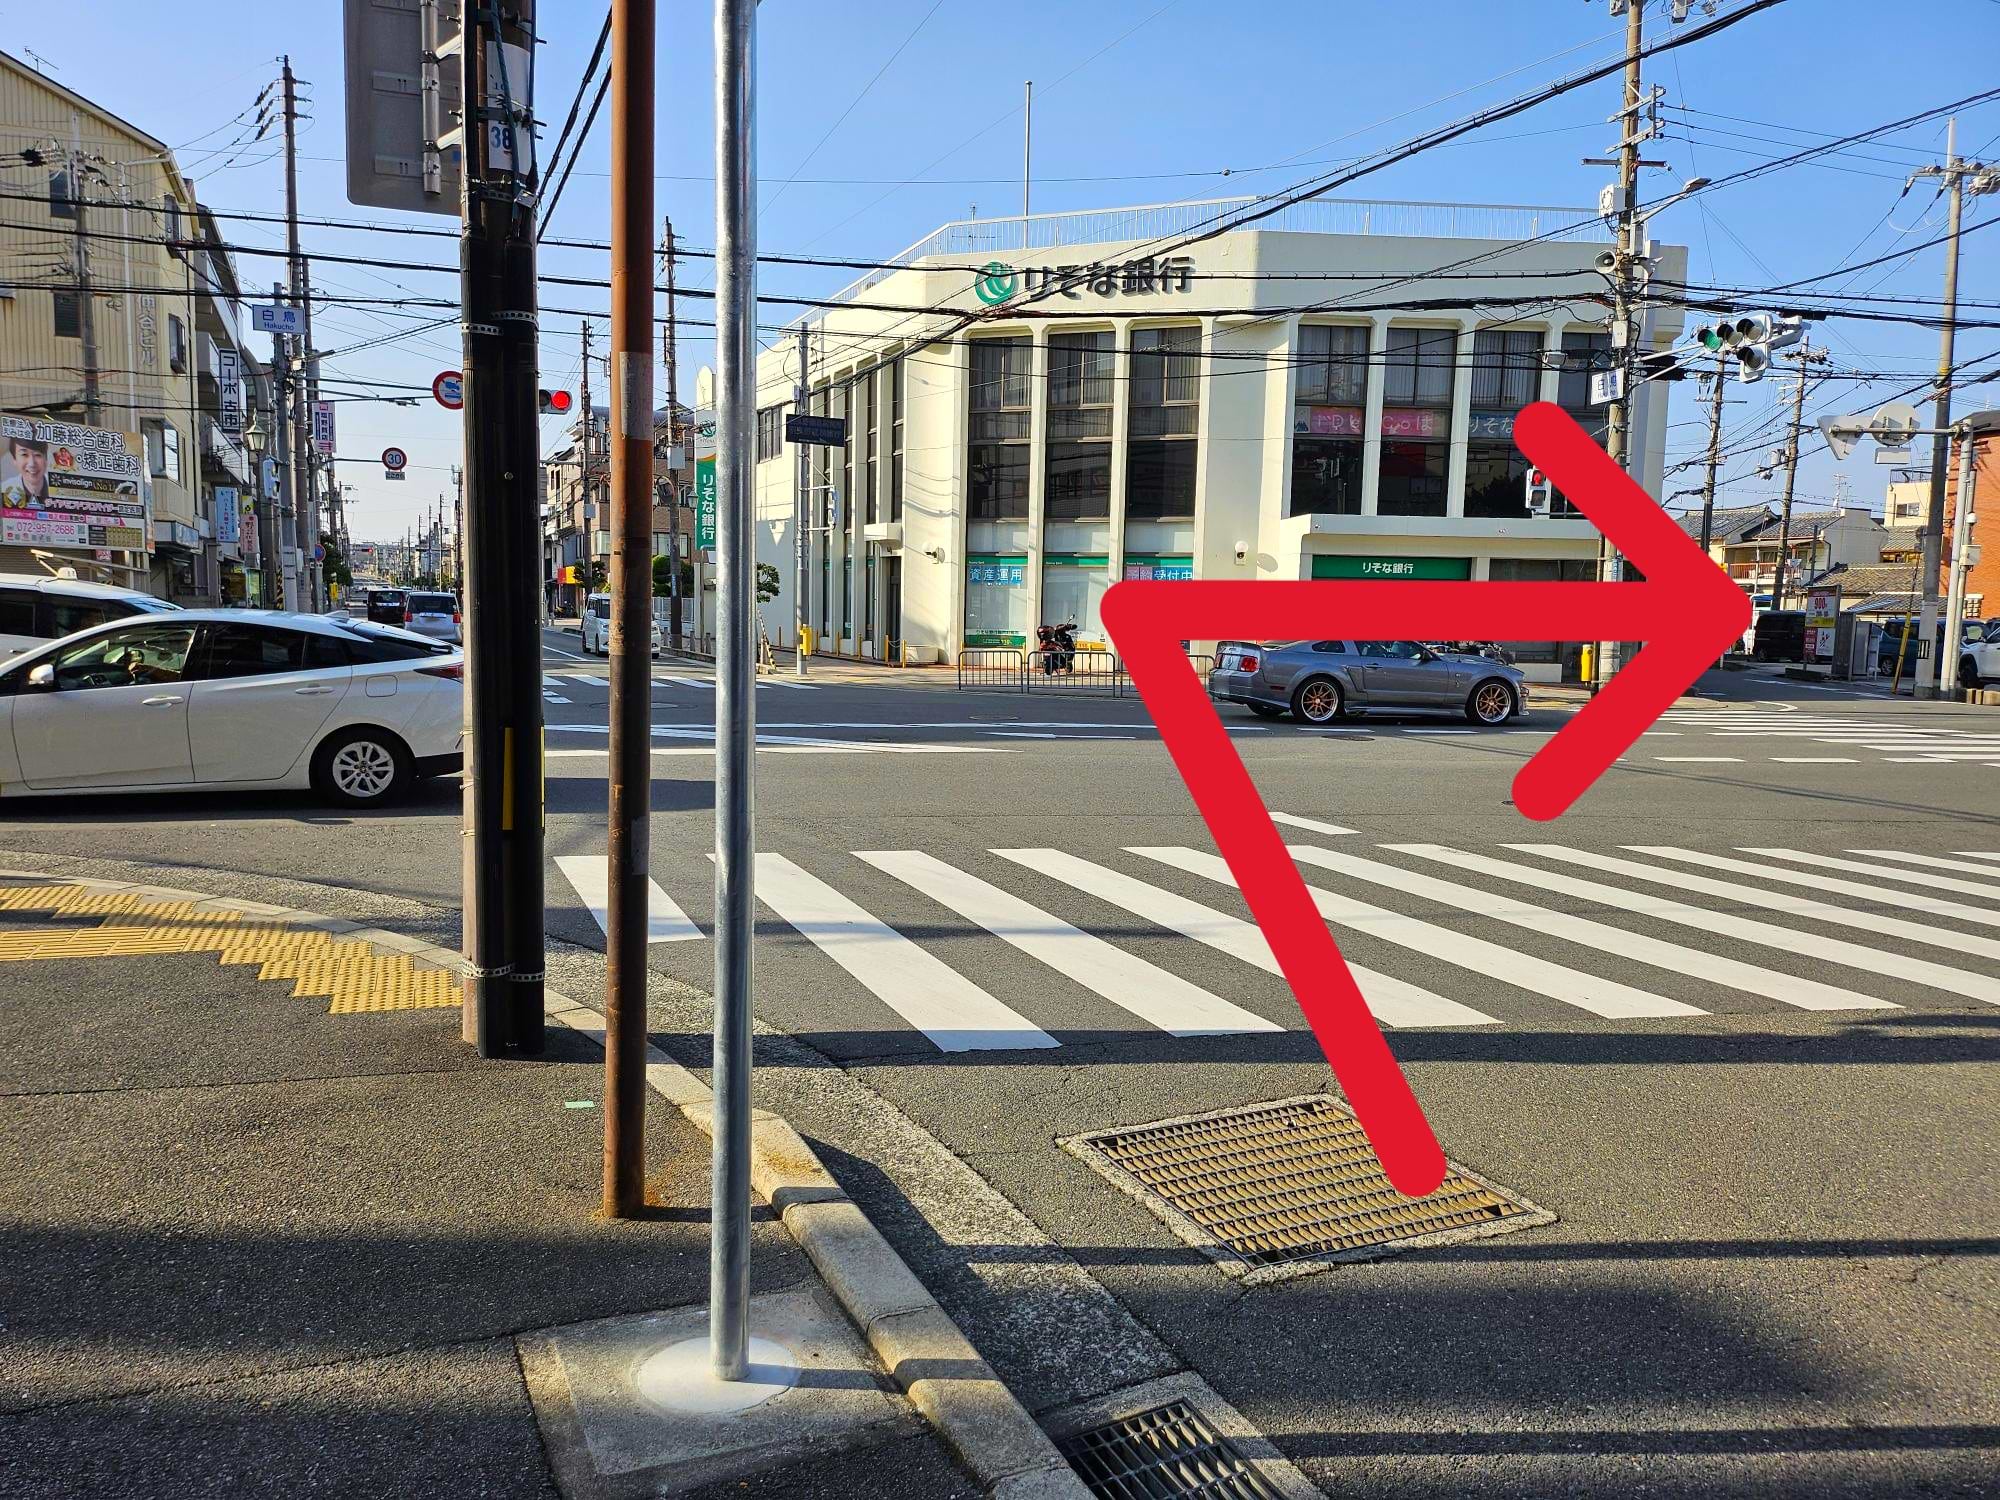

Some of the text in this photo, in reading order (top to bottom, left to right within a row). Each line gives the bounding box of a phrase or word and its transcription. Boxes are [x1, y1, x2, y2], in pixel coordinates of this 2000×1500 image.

[490, 126, 512, 149] 38
[1024, 256, 1193, 299] りそな銀行
[262, 310, 296, 324] 白鳥
[264, 321, 295, 332] Hakucho
[36, 421, 126, 452] 加藤総合歯科
[388, 454, 401, 464] 30
[62, 477, 93, 487] invisalign
[702, 475, 715, 540] りそな銀行
[16, 521, 75, 535] 072-957-2686
[969, 568, 1022, 581] 資産運用
[1362, 562, 1414, 575] りそな銀行
